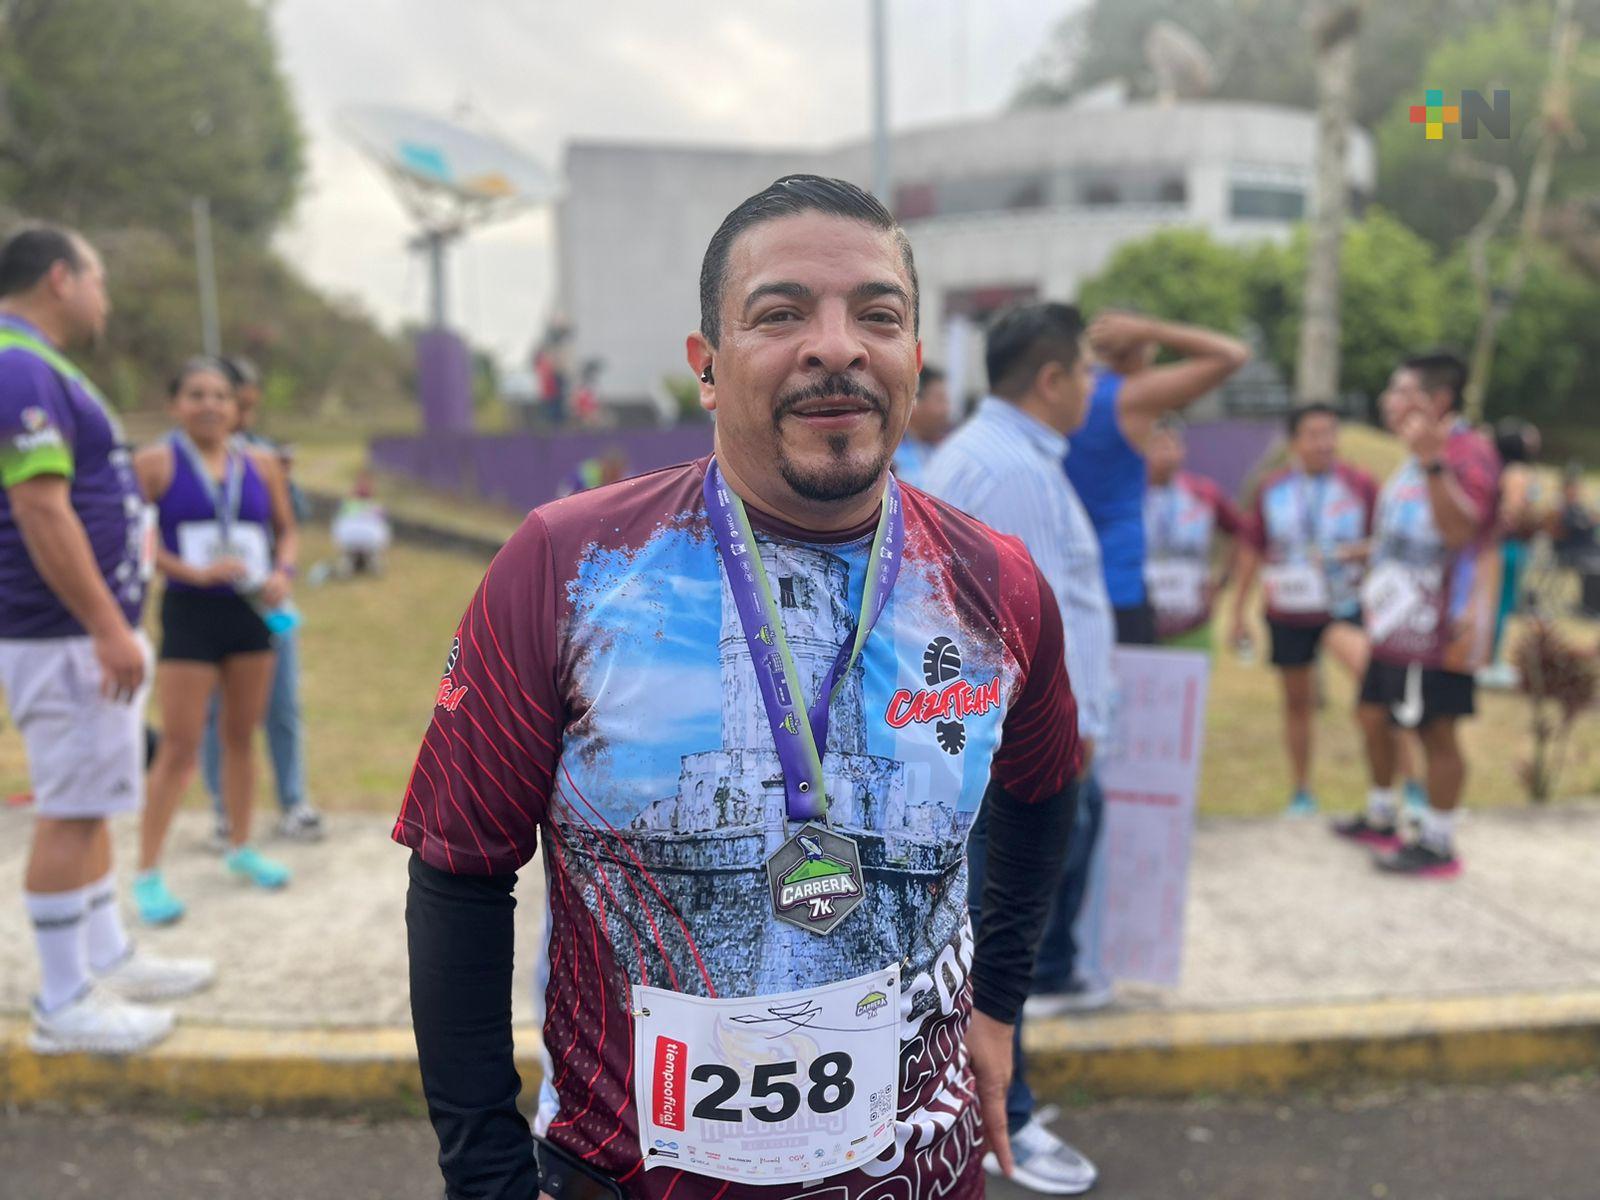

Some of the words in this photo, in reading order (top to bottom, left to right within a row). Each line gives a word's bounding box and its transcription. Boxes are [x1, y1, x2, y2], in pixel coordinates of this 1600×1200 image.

[782, 875, 855, 905] CARRERA
[809, 897, 833, 917] 7K
[662, 1043, 679, 1127] tiempooficial
[690, 1051, 855, 1123] 258
